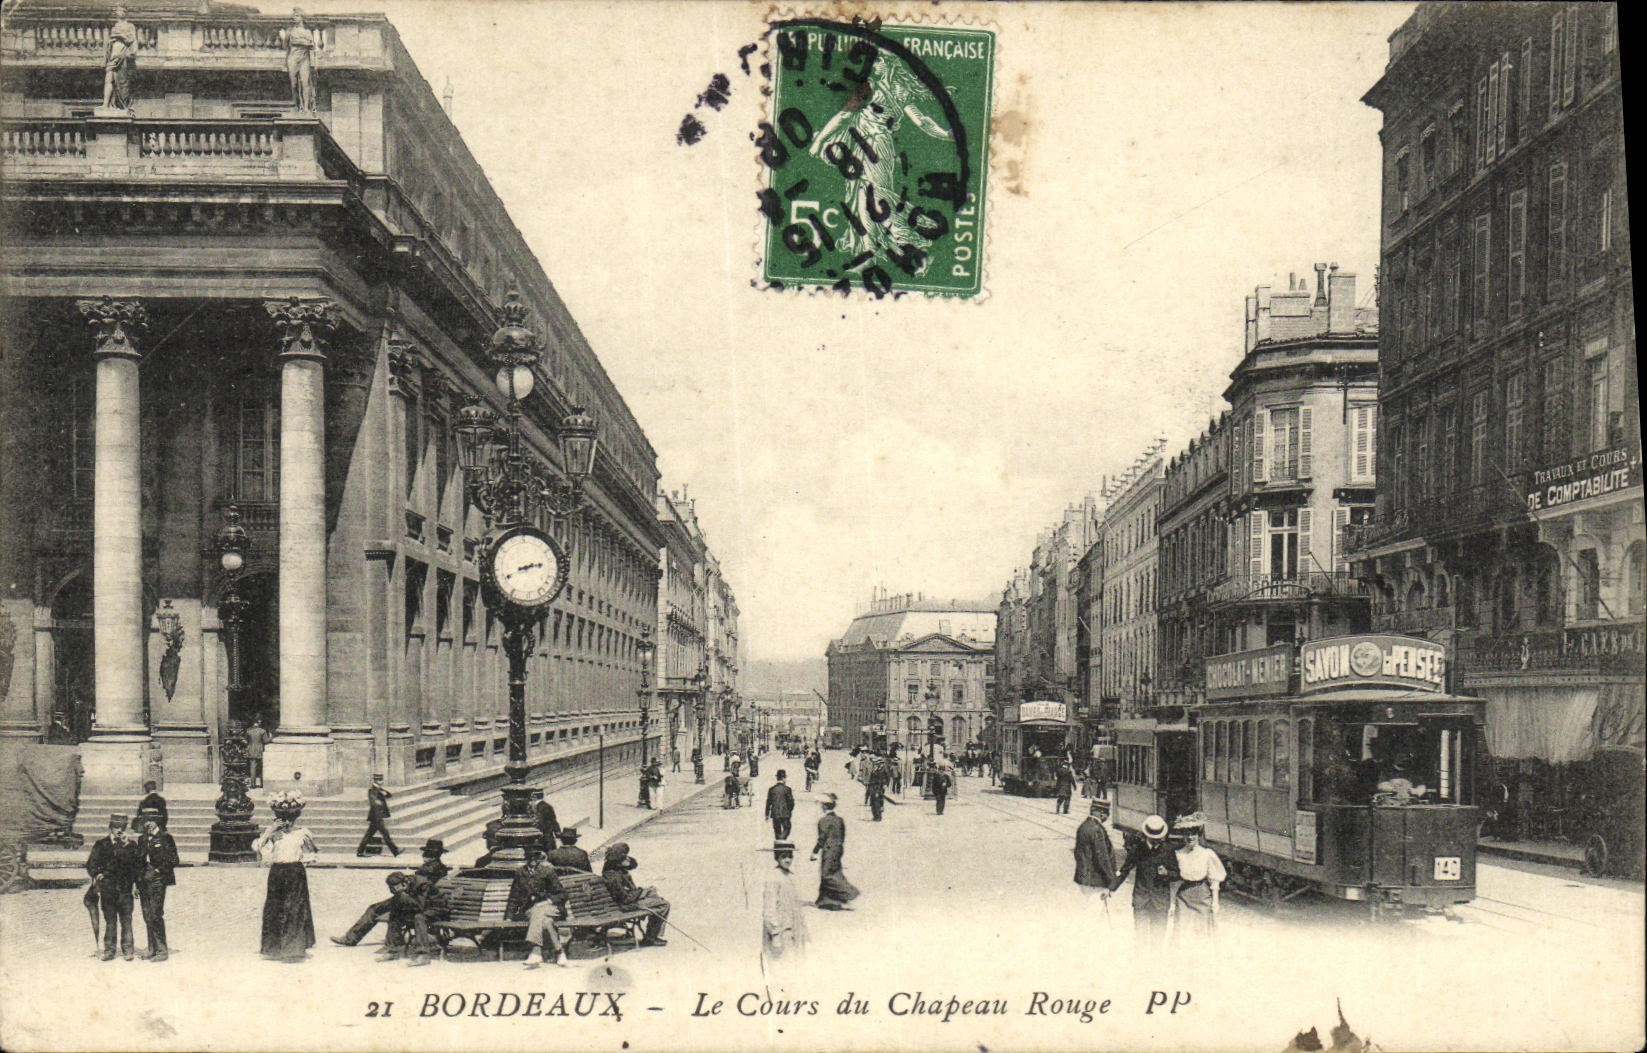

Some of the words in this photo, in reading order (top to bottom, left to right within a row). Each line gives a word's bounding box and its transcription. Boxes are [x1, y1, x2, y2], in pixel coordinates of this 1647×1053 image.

[903, 37, 986, 60] FRANÇAISE
[1534, 463, 1574, 485] TRAVAUX
[1591, 448, 1628, 470] COURS
[1527, 491, 1542, 511] DE
[1304, 644, 1350, 684] SAVON
